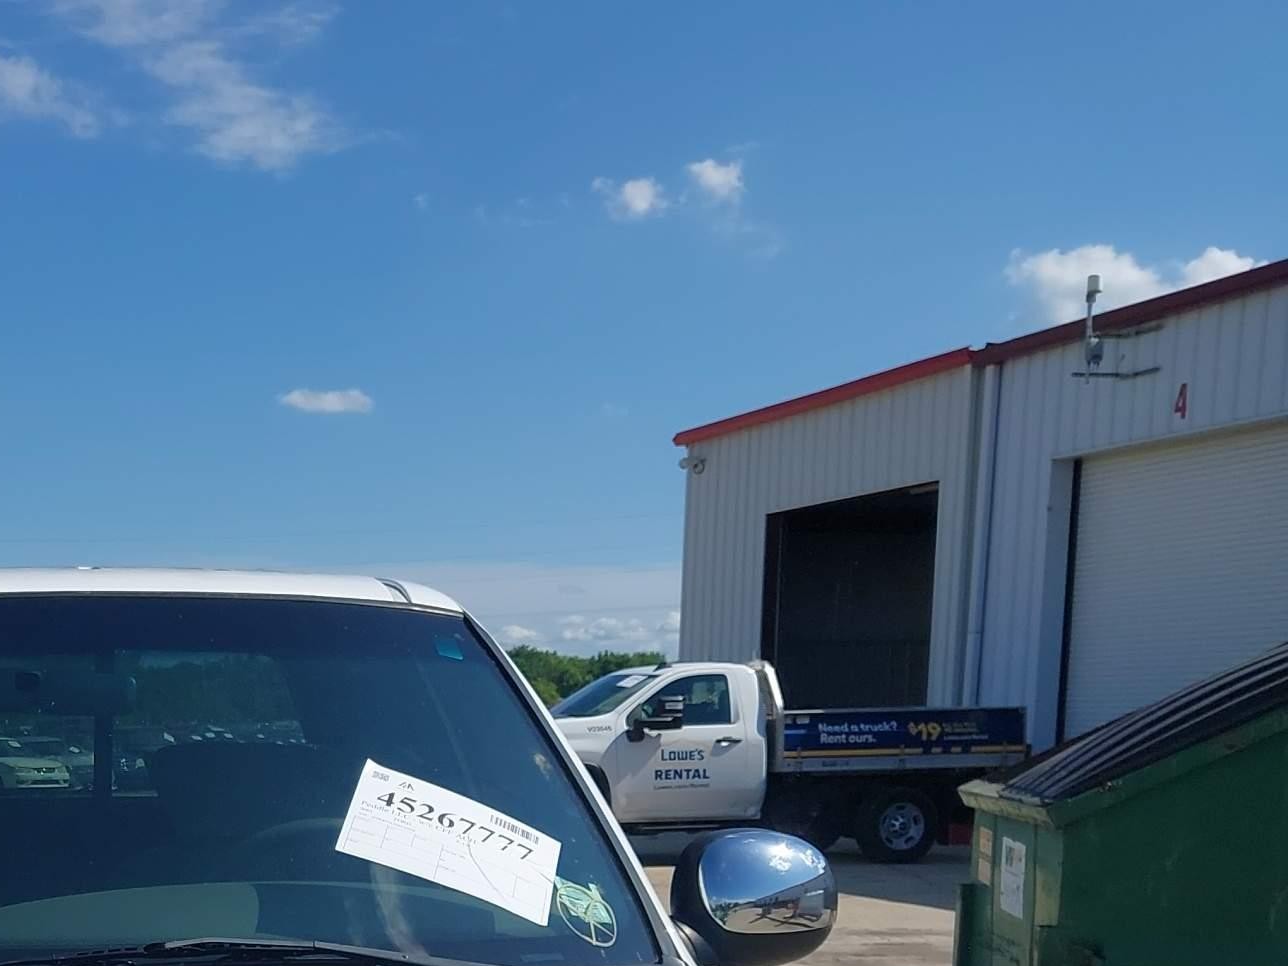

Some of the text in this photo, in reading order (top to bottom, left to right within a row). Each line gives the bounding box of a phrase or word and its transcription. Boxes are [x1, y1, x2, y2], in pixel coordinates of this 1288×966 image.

[1173, 382, 1188, 420] 4
[818, 720, 898, 732] Need a truck?
[907, 721, 941, 741] $19
[820, 733, 877, 744] Rent ours.
[654, 768, 711, 781] RENTAL
[376, 791, 534, 861] 45267777
